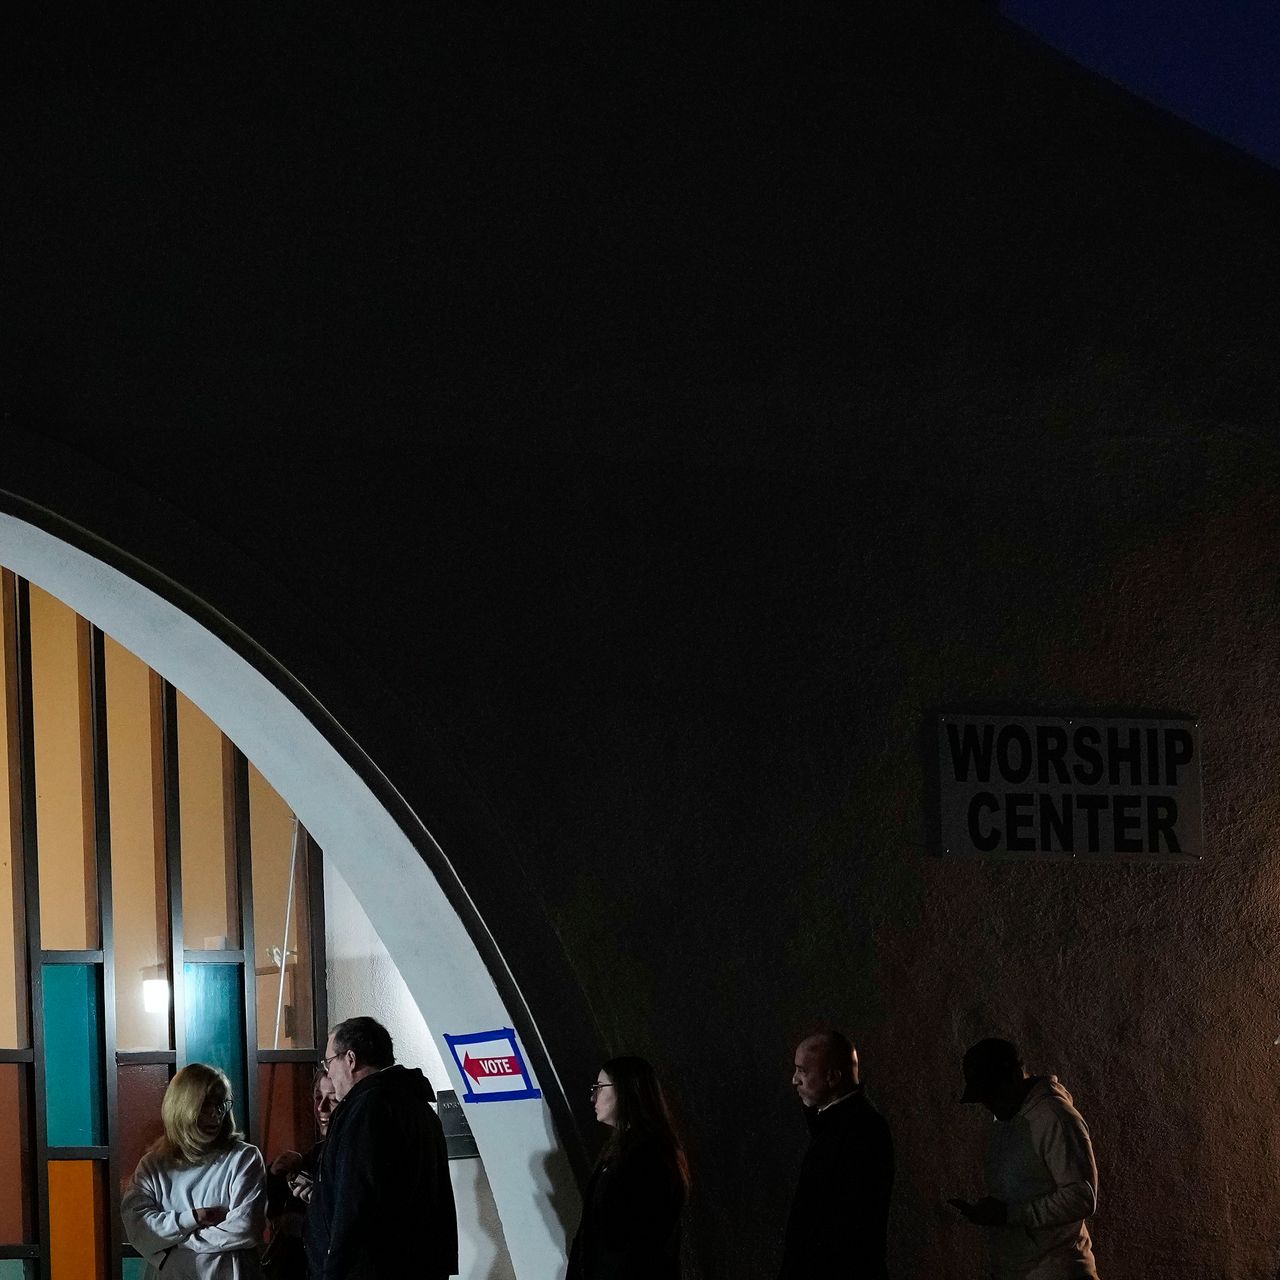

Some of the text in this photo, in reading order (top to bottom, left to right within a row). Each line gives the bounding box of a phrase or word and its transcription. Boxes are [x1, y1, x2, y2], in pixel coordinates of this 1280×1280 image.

[946, 723, 1194, 786] WORSHIP
[967, 791, 1182, 853] CENTER
[479, 1059, 513, 1075] VOTE
